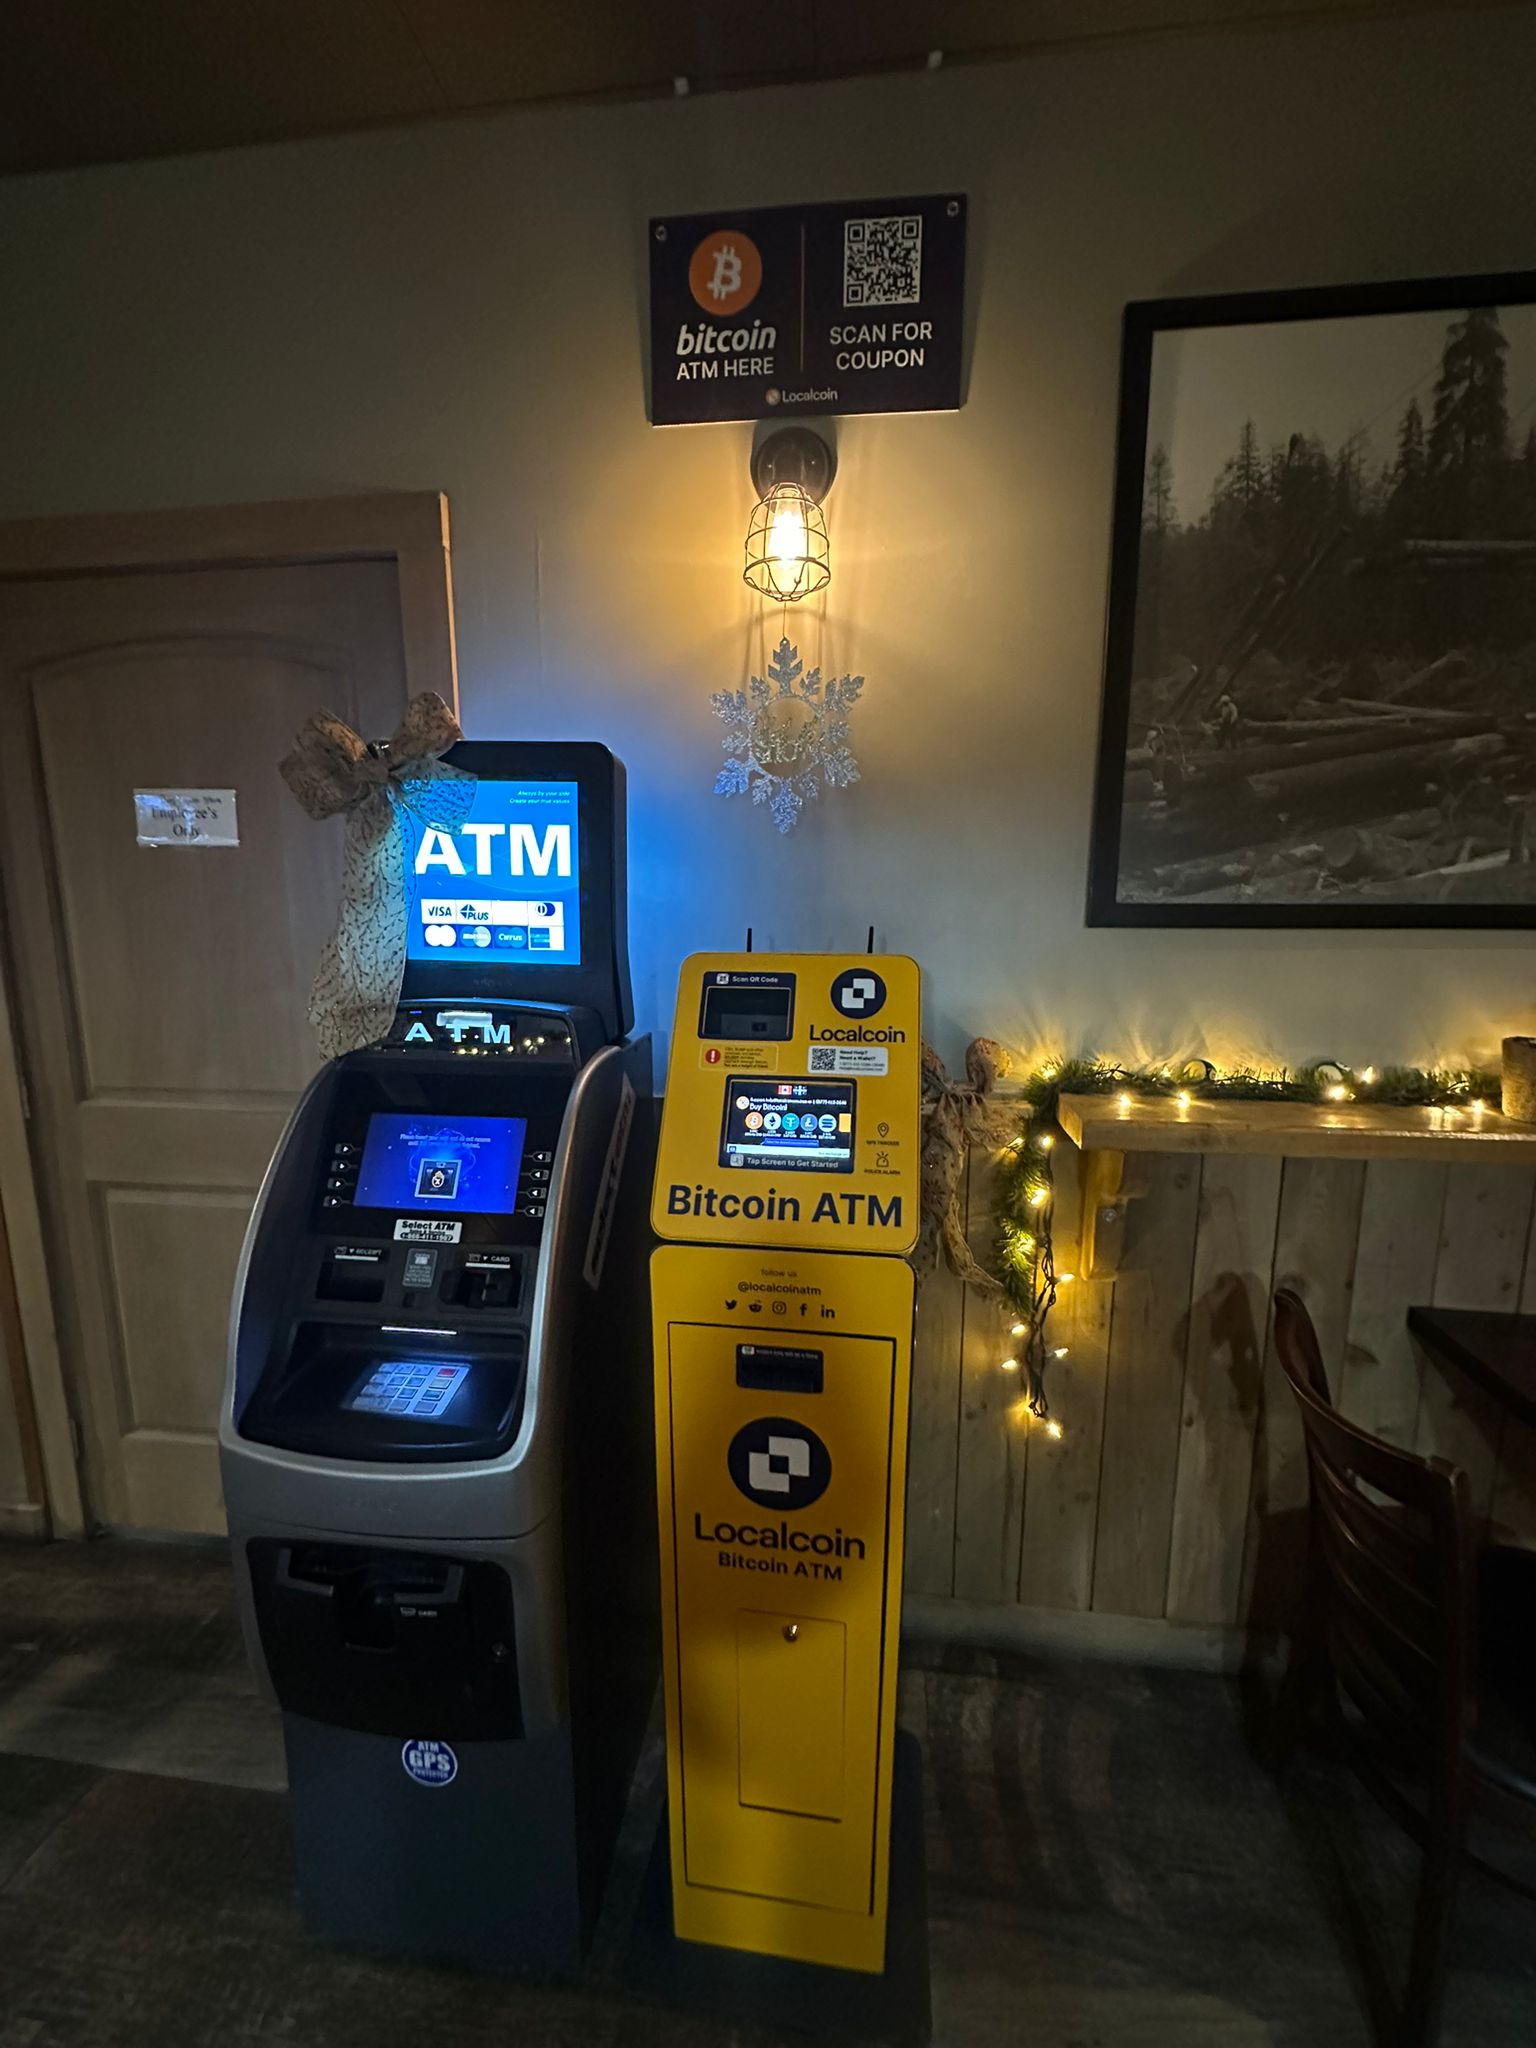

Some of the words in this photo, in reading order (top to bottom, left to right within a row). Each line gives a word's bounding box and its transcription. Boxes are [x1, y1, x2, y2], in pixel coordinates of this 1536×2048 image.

[676, 319, 777, 355] bitcoin
[829, 324, 886, 345] SCAN
[892, 321, 933, 342] FOR
[676, 361, 718, 381] ATM
[723, 356, 774, 378] HERE
[836, 348, 925, 370] COUPON
[782, 387, 838, 403] Localcoin
[415, 823, 571, 877] ATM
[428, 906, 452, 917] VISA
[467, 911, 490, 921] PLUS
[498, 932, 523, 941] Cirrus
[404, 1022, 511, 1044] ATM
[809, 1024, 906, 1043] Localcoin
[749, 1103, 762, 1111] Buy
[747, 1157, 760, 1165] Tap
[762, 1157, 787, 1166] Screen
[788, 1158, 796, 1166] to
[797, 1158, 810, 1166] Get
[811, 1160, 839, 1168] Started
[667, 1184, 800, 1221] Bitcoin
[811, 1192, 903, 1229] ATM
[402, 1220, 432, 1230] Select
[434, 1223, 456, 1231] ATM
[738, 1281, 822, 1296] @localcoinatm
[695, 1512, 865, 1560] Localcoin
[718, 1552, 788, 1574] Bitcoin
[794, 1562, 842, 1581] ATM
[408, 1749, 450, 1772] GPS
